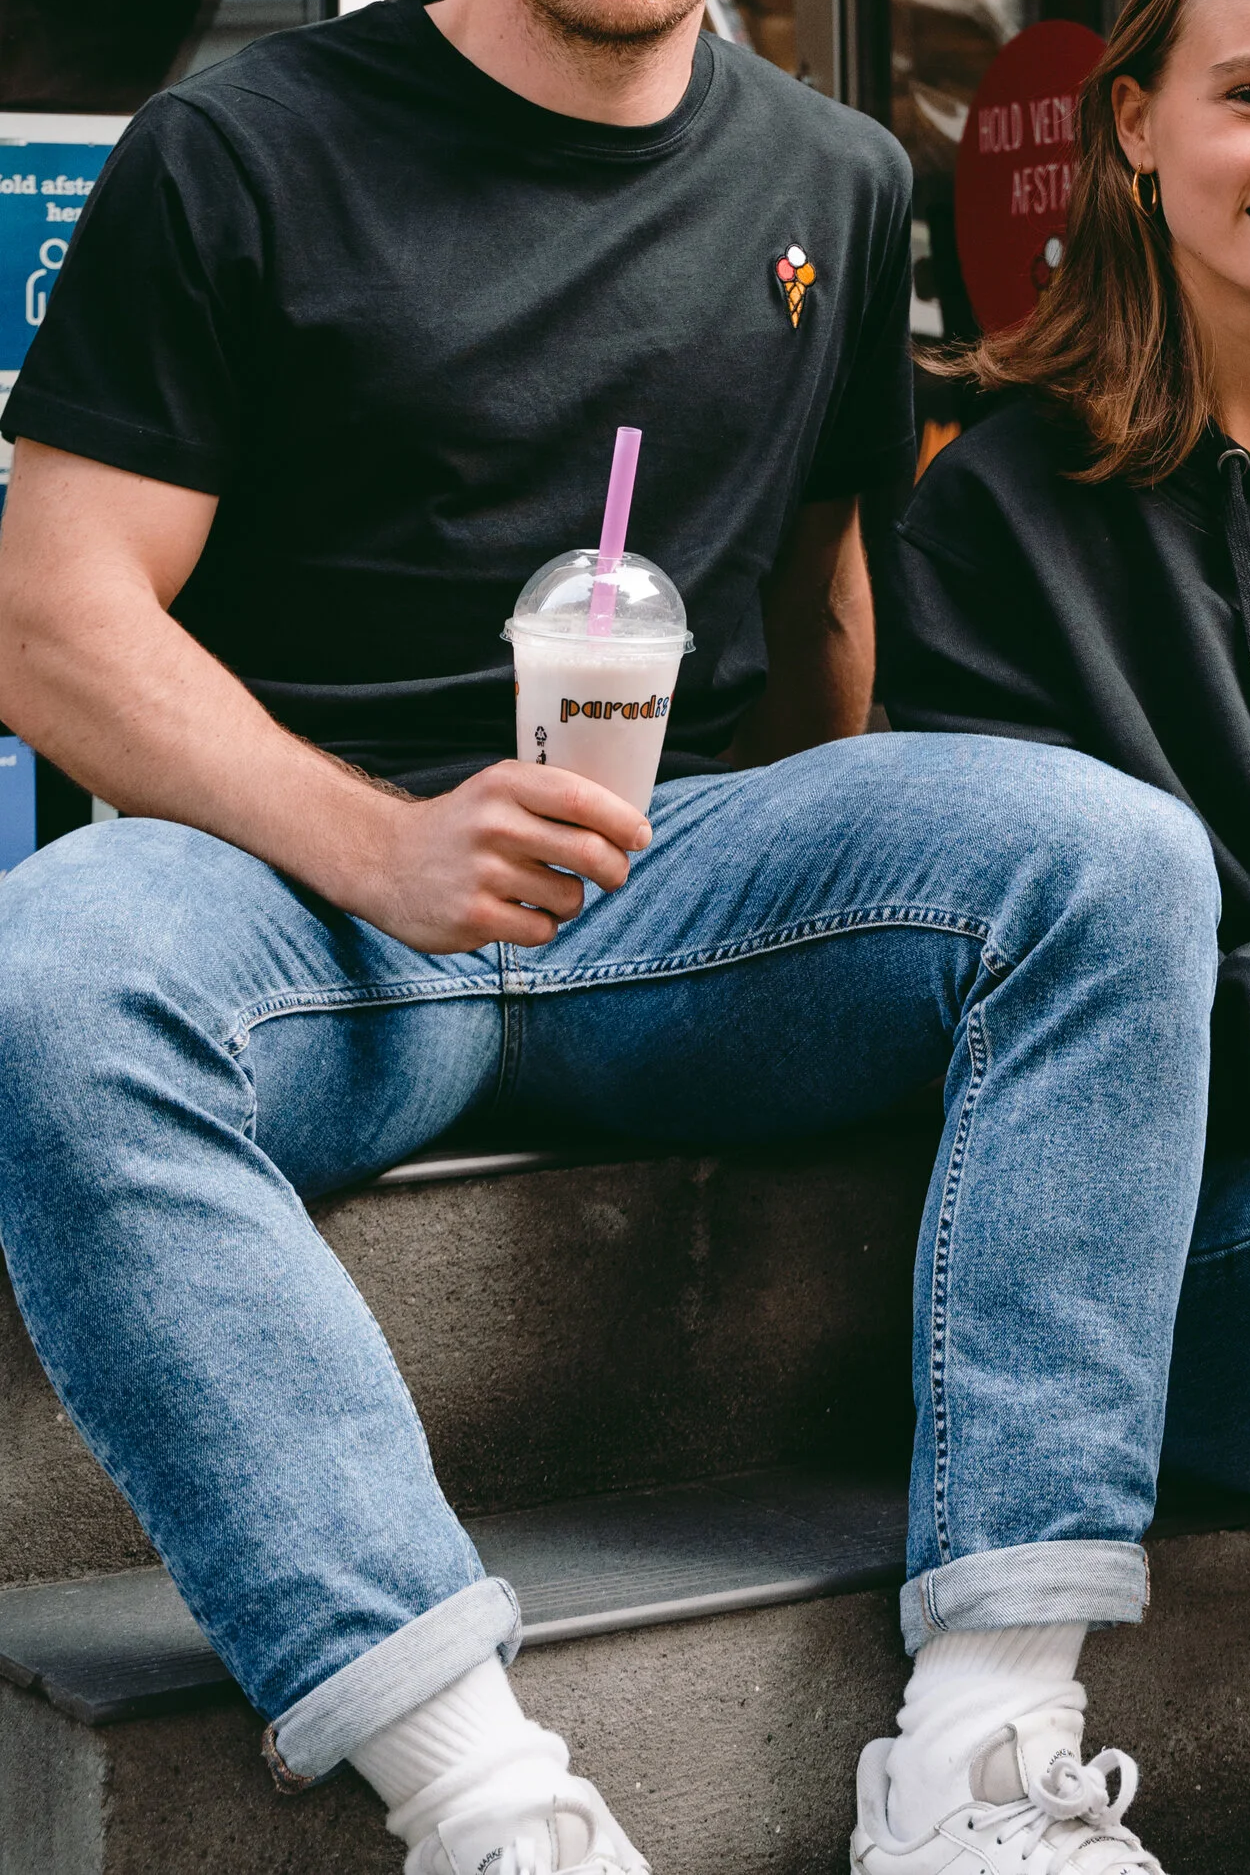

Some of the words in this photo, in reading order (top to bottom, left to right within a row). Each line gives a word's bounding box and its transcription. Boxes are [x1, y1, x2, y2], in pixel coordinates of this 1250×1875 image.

[978, 102, 1023, 154] HOLD
[0, 173, 39, 195] old
[560, 694, 670, 724] paradis
[477, 1846, 504, 1873] MARKE
